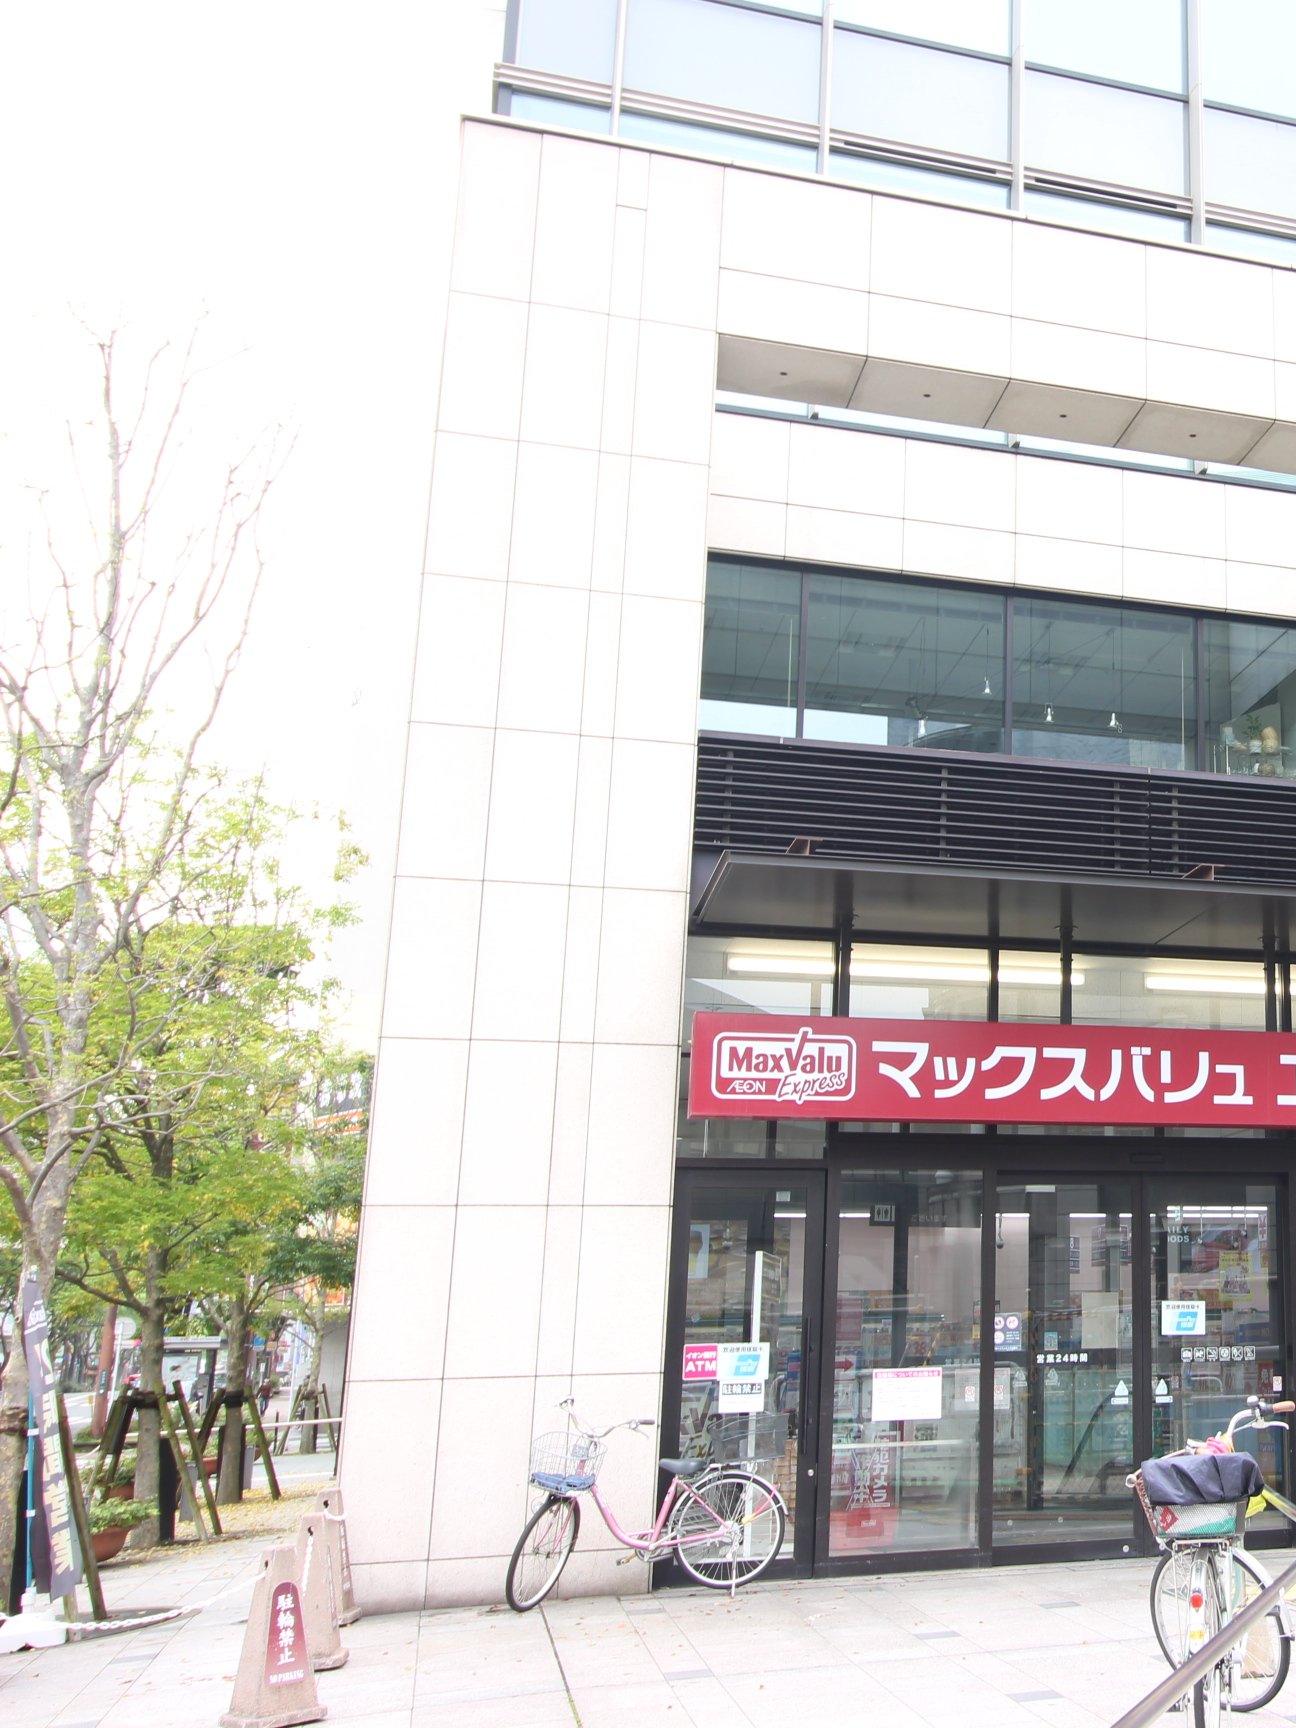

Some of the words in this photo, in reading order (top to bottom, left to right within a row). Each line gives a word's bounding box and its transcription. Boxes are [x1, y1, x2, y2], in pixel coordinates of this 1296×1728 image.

[728, 1031, 842, 1074] MaxValu
[778, 1072, 846, 1101] Express
[872, 1040, 1254, 1105] マックスバリュ
[685, 1361, 717, 1372] ATM
[1036, 1353, 1088, 1363] 営業24時間
[722, 1383, 762, 1395] 駐輪禁止
[276, 1593, 296, 1666] 駐輪禁止
